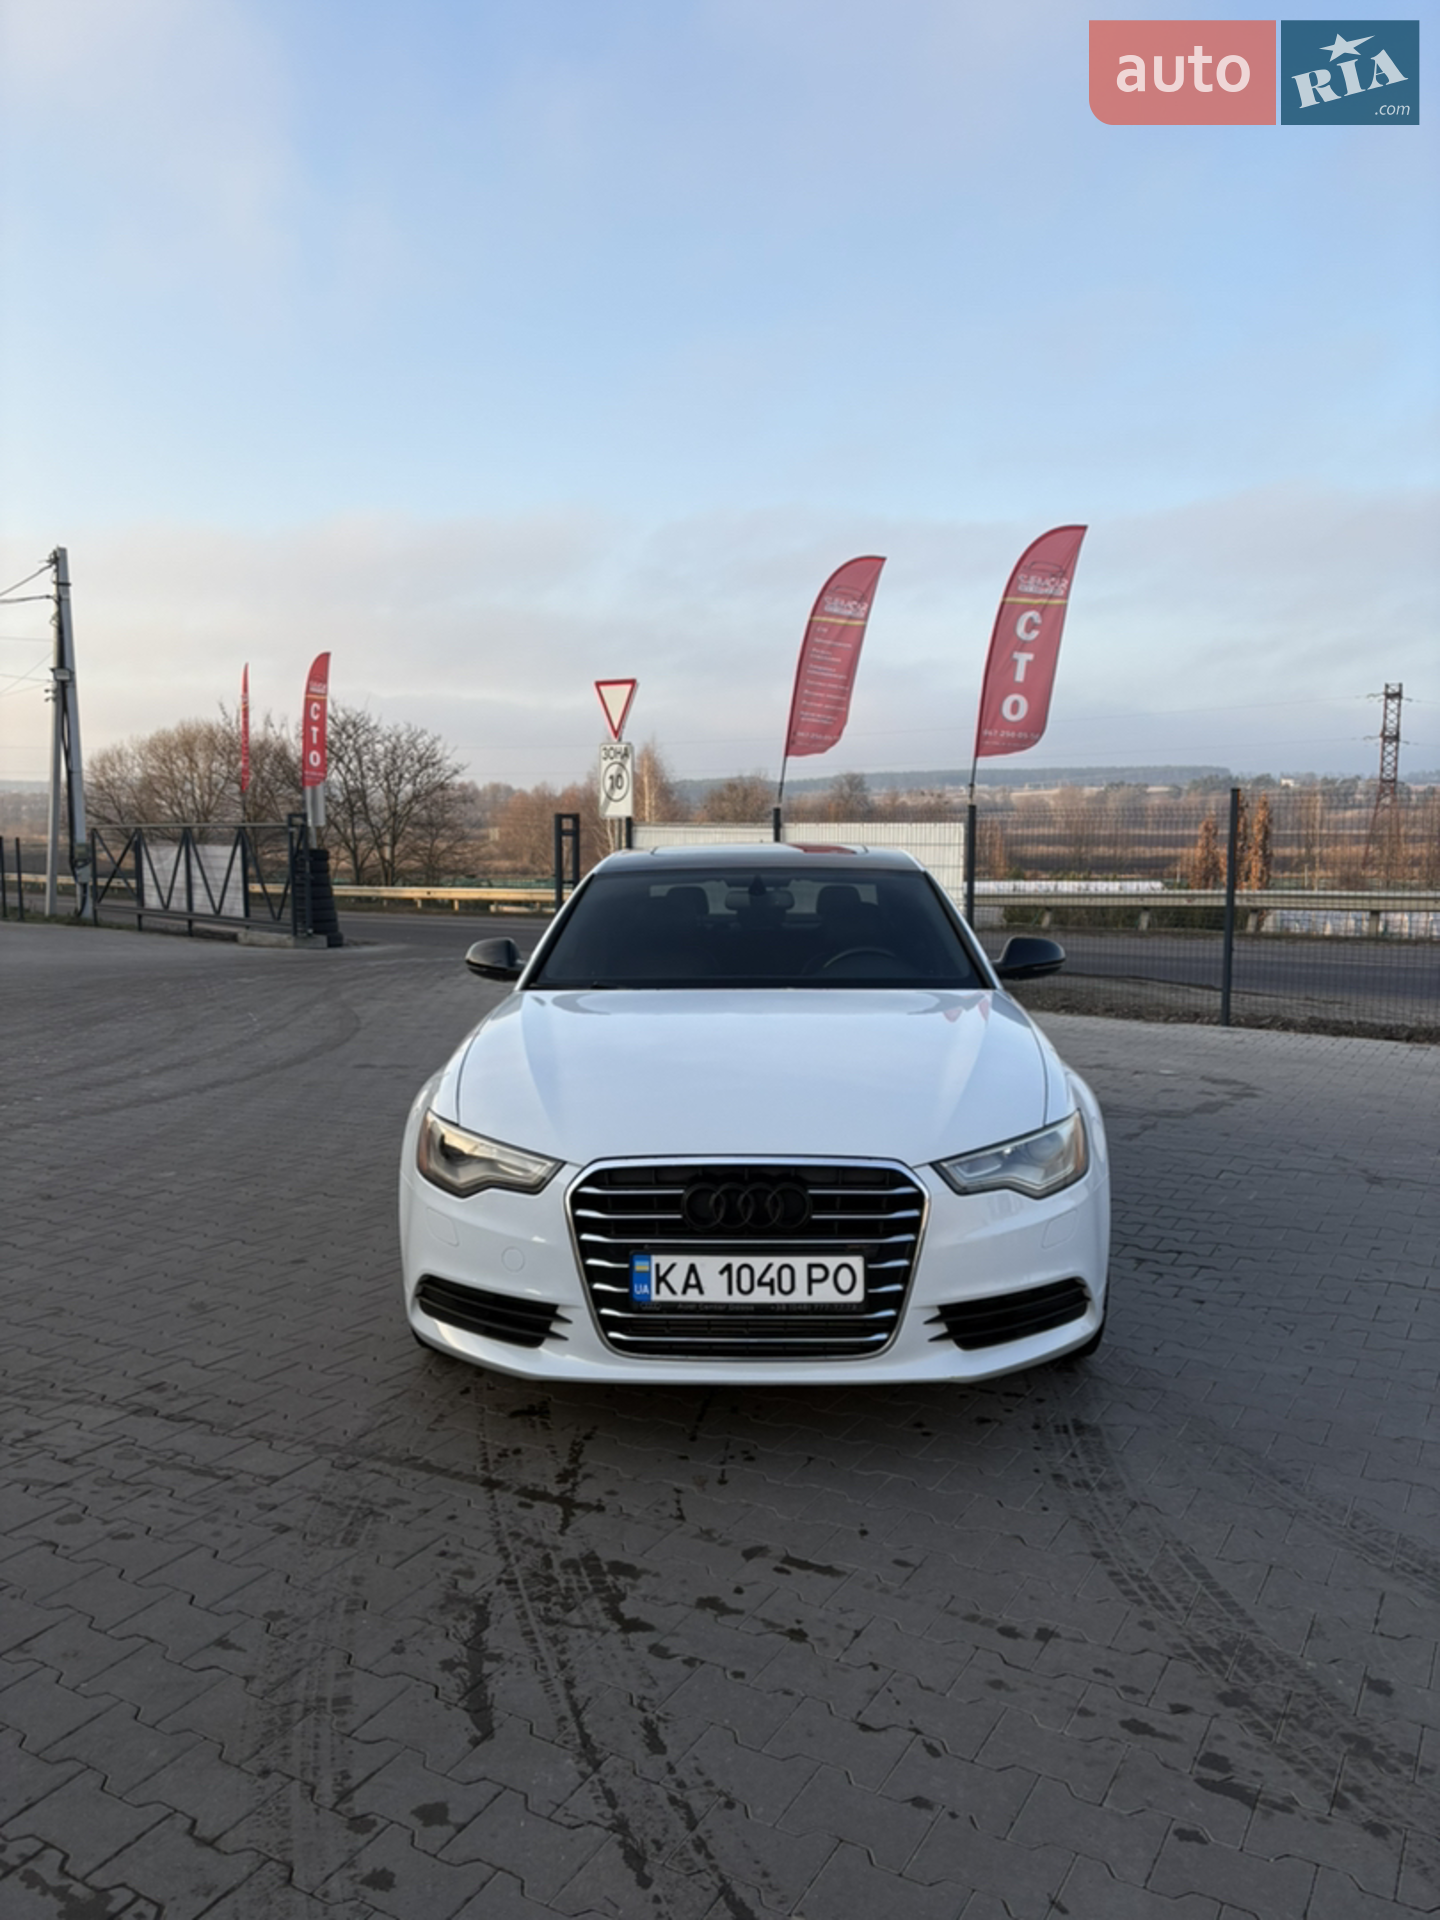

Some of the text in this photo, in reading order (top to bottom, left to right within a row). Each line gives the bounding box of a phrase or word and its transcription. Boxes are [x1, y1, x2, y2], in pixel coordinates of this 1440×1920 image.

[1001, 610, 1042, 722] СТО
[309, 702, 321, 767] СТО
[602, 746, 629, 760] ЗОНА
[608, 773, 624, 790] 10
[634, 1284, 650, 1295] UA
[655, 1262, 857, 1296] KA 1040 PO
